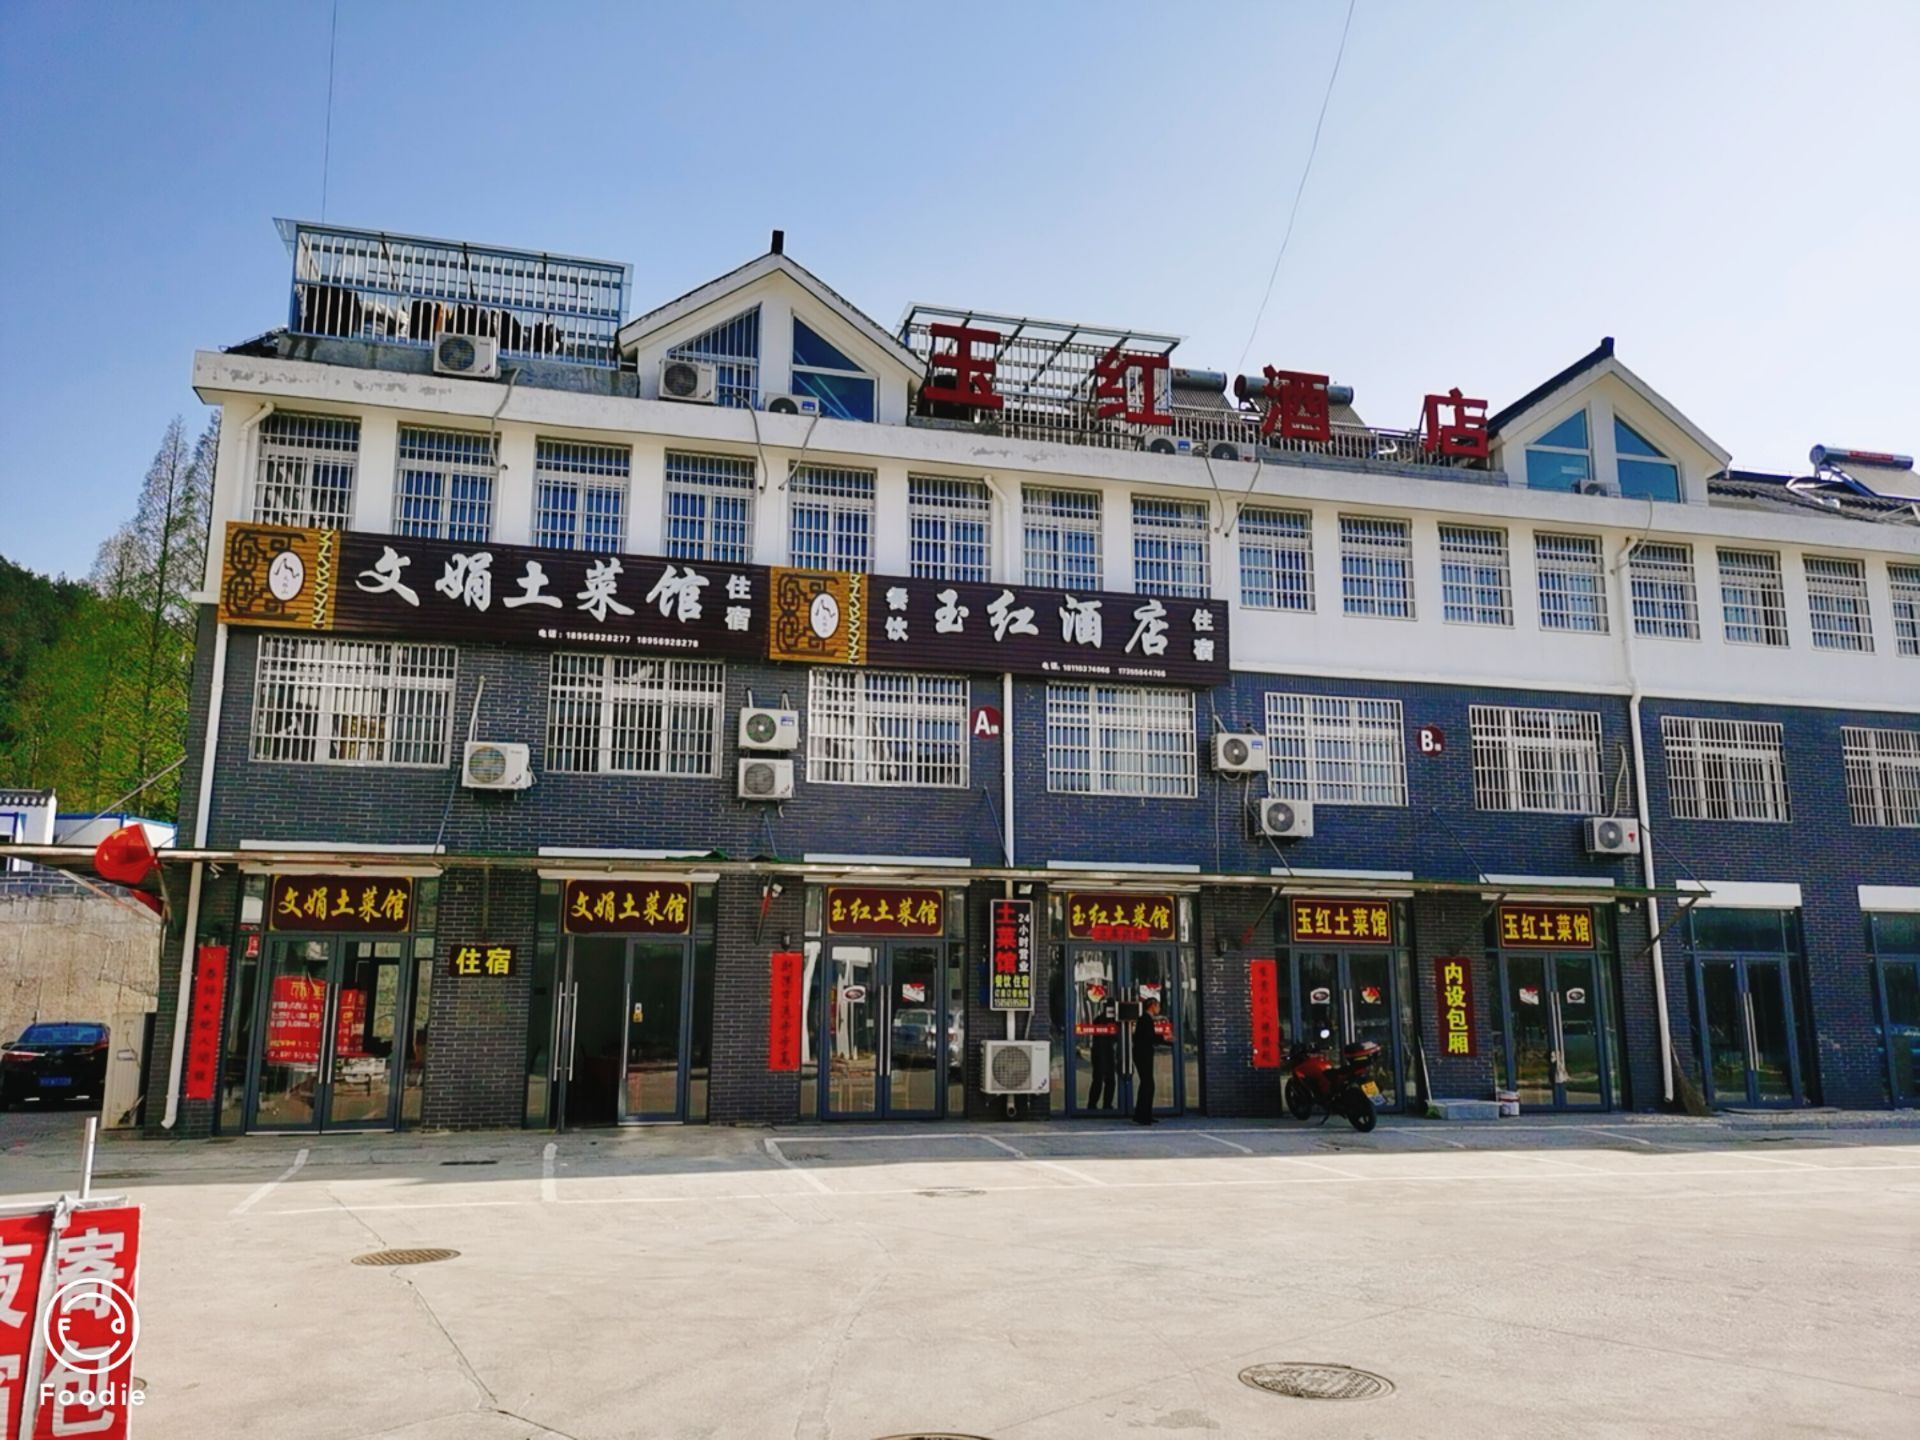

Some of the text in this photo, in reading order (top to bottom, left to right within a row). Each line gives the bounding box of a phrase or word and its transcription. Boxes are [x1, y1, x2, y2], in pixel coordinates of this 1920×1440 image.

[923, 323, 1489, 458] 玉红酒店
[355, 545, 710, 624] 文娟土菜馆
[725, 574, 752, 632] 住宿
[885, 587, 909, 641] 餐饮
[934, 589, 1170, 656] 玉红酒店
[1192, 608, 1215, 661] 住宿
[277, 886, 408, 922] 文娟土菜馆
[570, 889, 689, 926] 文娟土菜馆
[831, 897, 939, 927] 玉红土菜馆
[1072, 902, 1171, 930] 玉红土菜馆
[1296, 907, 1388, 937] 玉红土菜馆
[1504, 913, 1590, 943] 玉红土菜馆
[455, 947, 512, 975] 住宿
[994, 899, 1017, 974] 土菜馆
[1444, 962, 1469, 1055] 内设包厢
